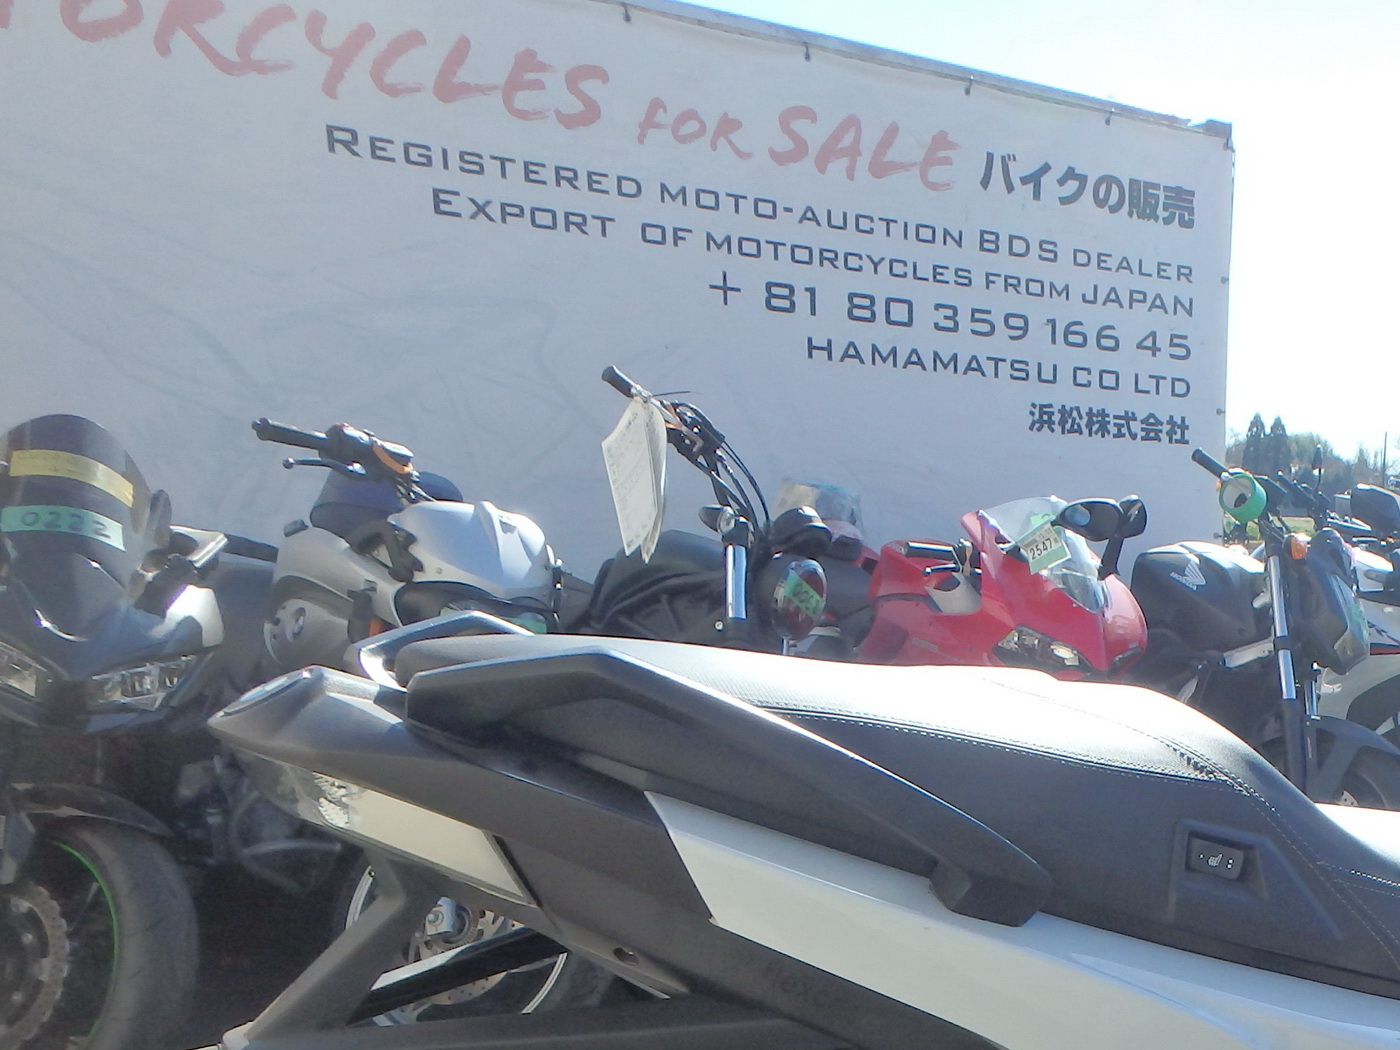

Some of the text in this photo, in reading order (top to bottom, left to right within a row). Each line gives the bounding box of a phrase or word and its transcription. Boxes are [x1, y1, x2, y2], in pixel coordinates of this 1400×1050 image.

[0, 0, 962, 192] ORCYCLES FOR SALE
[325, 123, 1194, 284] REGISTERED MOTO-AUCTION BDS DEALER
[979, 151, 1196, 229] バイクの販売
[431, 187, 1194, 318] EXPORT OF MOTORCYCLES FROM JAPAN
[764, 281, 818, 317] 81
[846, 291, 914, 328] 80
[932, 302, 1030, 341] 359
[1045, 318, 1121, 352] 166
[1134, 330, 1192, 361] 45
[806, 336, 1191, 399] HAMAMATSU CO LTD
[1027, 401, 1190, 445] 浜松株式会社
[1029, 537, 1053, 560] 2547
